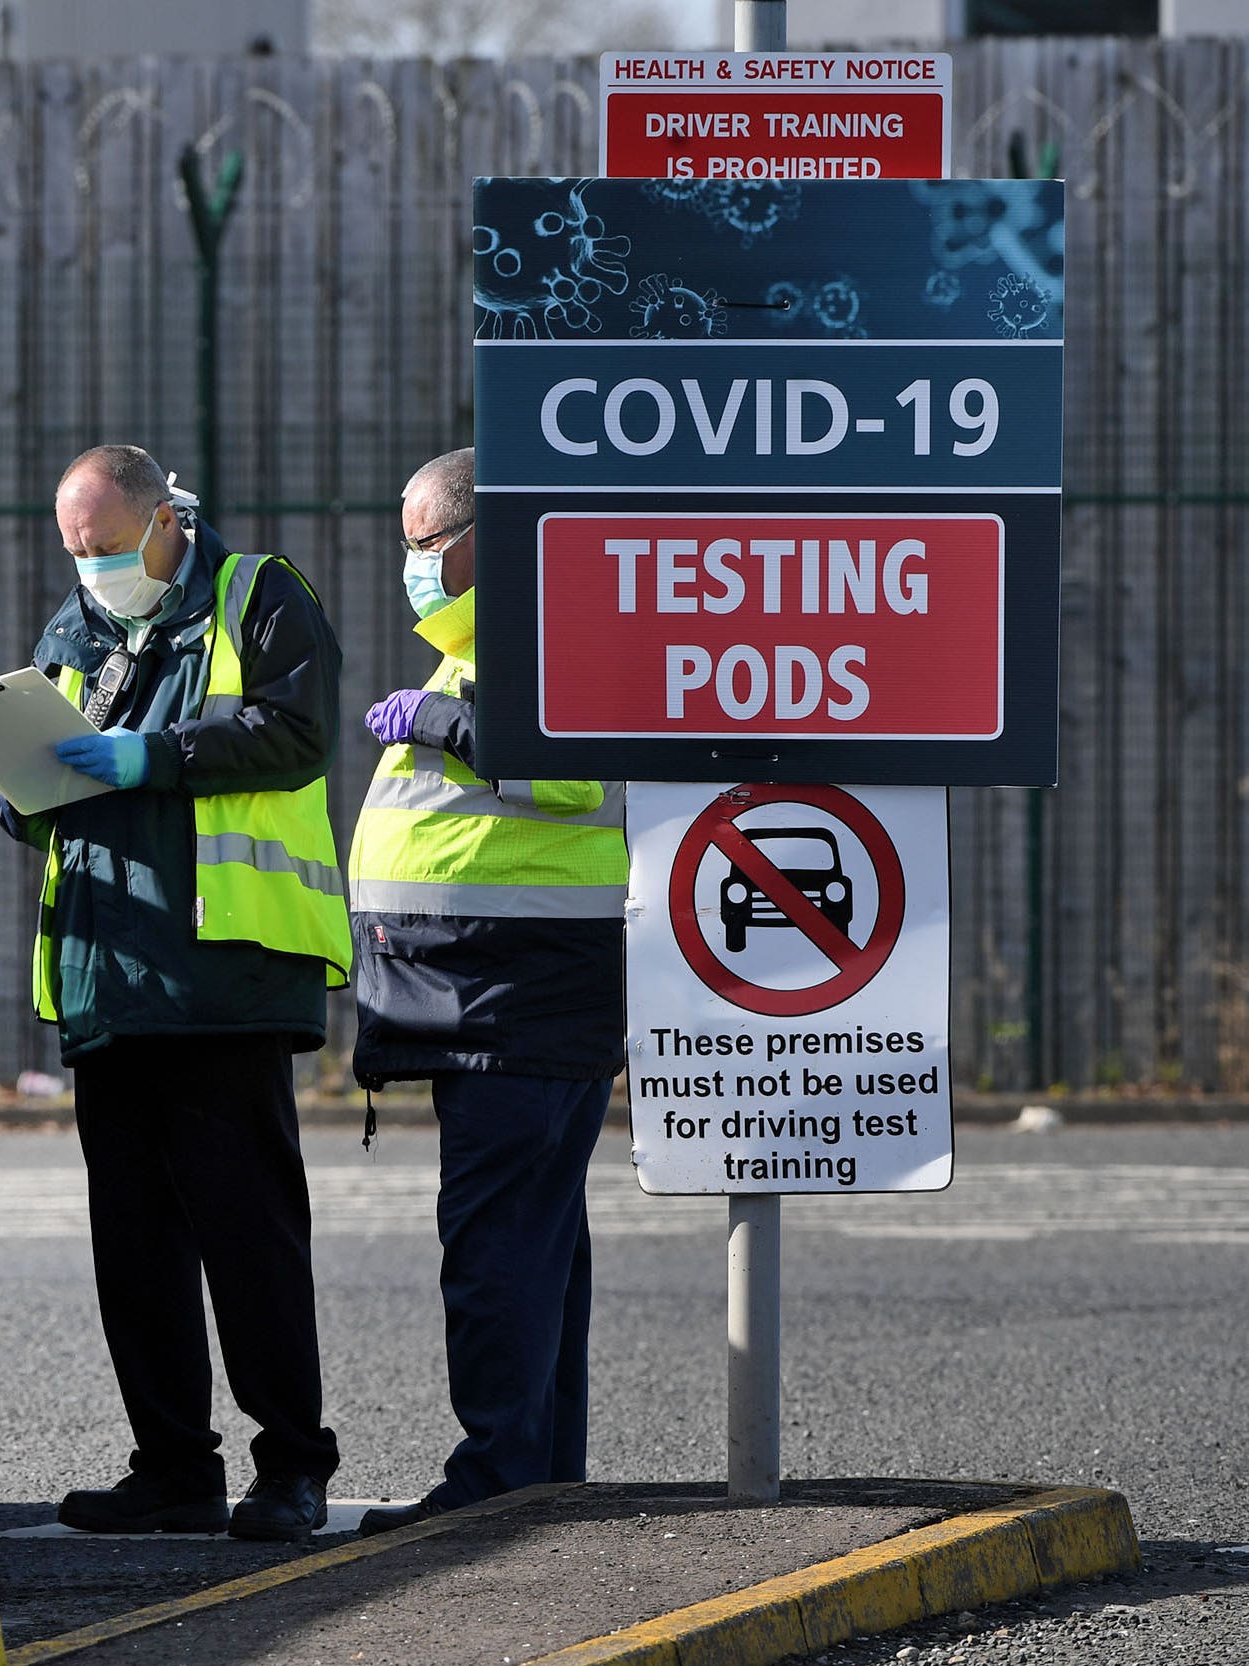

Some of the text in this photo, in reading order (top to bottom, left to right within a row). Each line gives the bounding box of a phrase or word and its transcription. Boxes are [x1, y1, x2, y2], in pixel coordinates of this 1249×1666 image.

[615, 60, 935, 79] HEALTH & SAFETY NOTICE
[645, 113, 904, 137] DRIVER TRAINING
[667, 157, 881, 178] IS PROHIBITED
[540, 377, 1000, 456] COVID-19
[604, 538, 929, 615] TESTING
[665, 645, 870, 720] PODS
[650, 1026, 925, 1061] These premises
[640, 1066, 938, 1097] must not be used
[663, 1109, 918, 1144] for driving test
[723, 1151, 857, 1185] training
